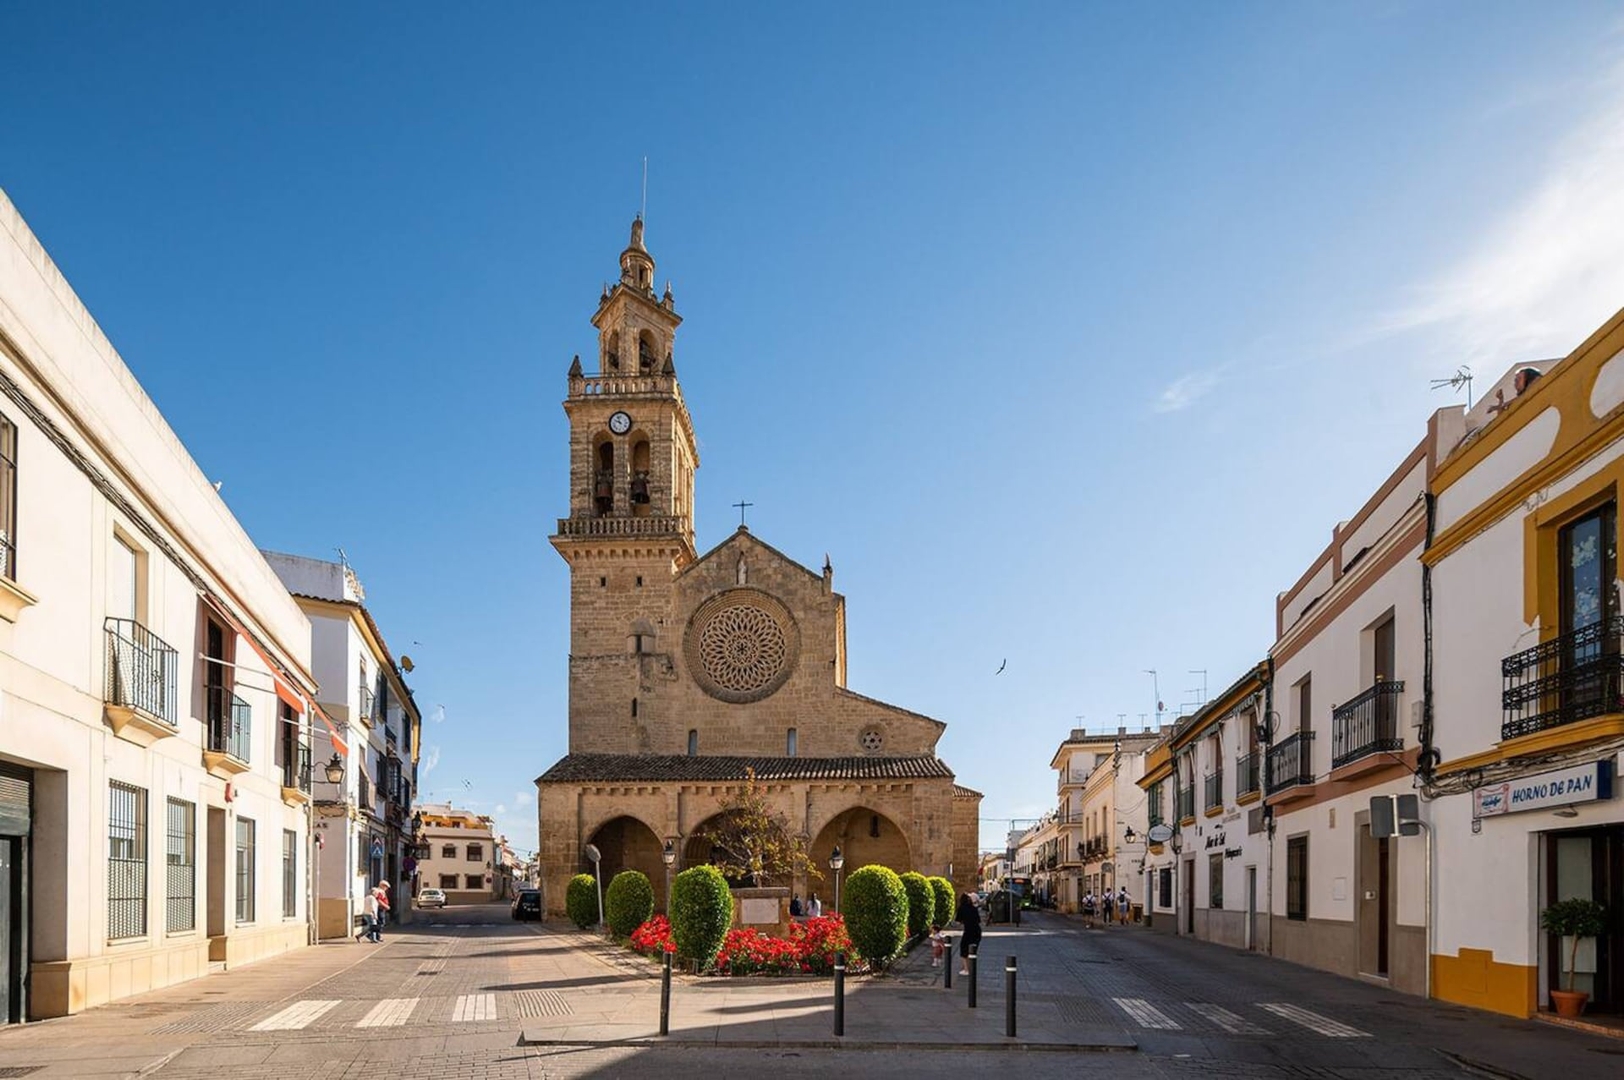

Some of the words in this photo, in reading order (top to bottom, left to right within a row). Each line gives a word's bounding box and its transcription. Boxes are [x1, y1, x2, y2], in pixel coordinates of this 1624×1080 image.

[1512, 785, 1548, 803] HORNO
[1549, 781, 1565, 797] DE
[1566, 774, 1592, 793] PAN
